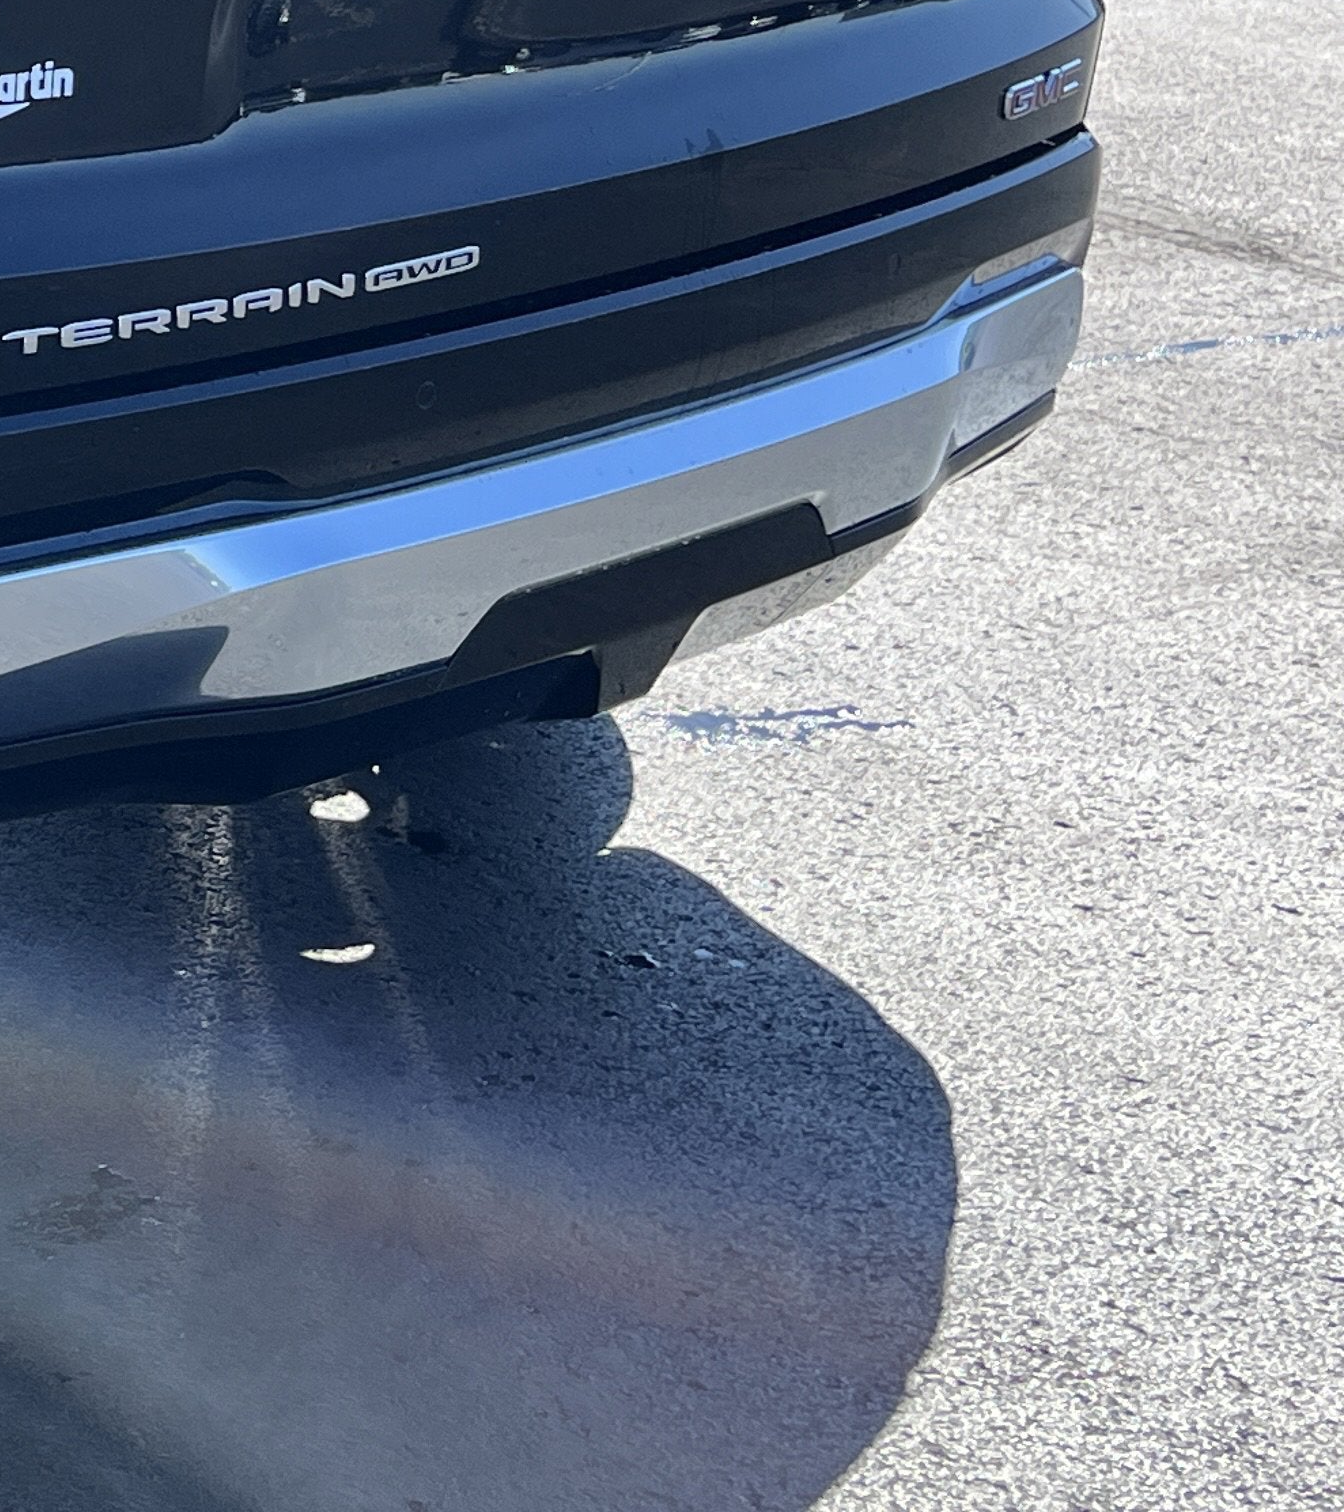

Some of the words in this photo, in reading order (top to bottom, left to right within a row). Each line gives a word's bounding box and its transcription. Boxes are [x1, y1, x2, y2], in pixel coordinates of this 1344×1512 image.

[1004, 58, 1082, 120] GMC
[2, 273, 355, 354] TERRAIN
[369, 247, 478, 290] AWD
